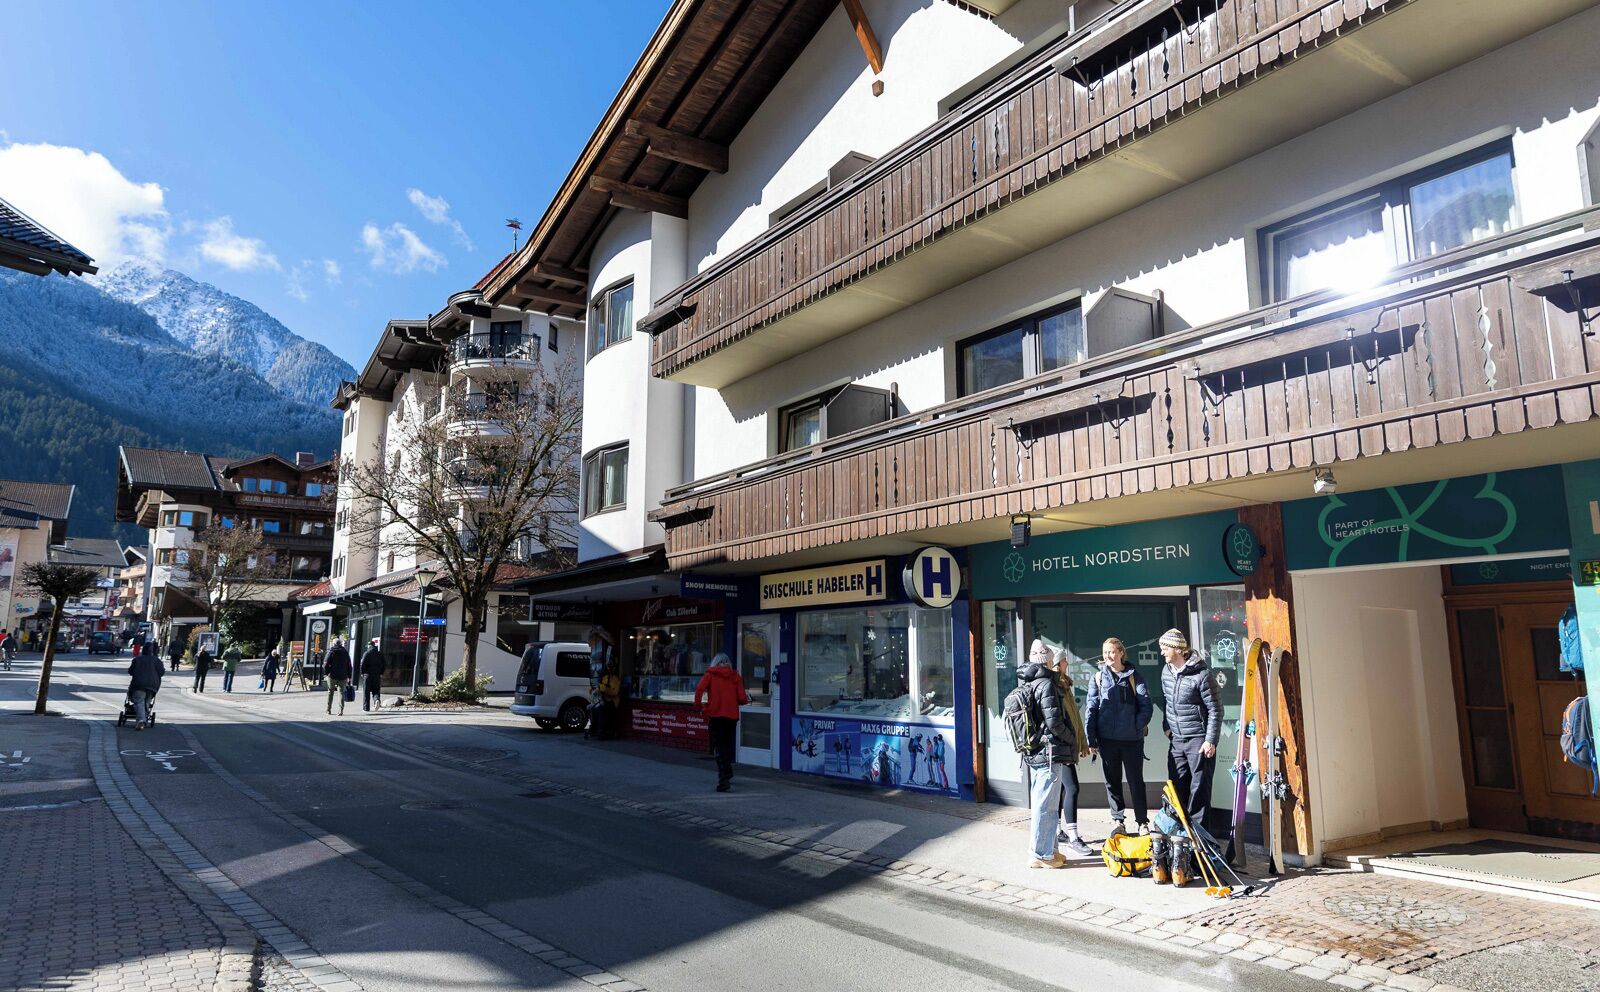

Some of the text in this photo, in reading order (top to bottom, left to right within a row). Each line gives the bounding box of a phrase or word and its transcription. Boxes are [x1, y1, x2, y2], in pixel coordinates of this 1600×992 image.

[1335, 519, 1375, 529] PART OF
[1336, 524, 1409, 538] HEART HOTELS
[1032, 543, 1190, 571] HOTEL NORDSTERN
[763, 564, 882, 600] SKISCHULE HABELER H
[922, 556, 951, 598] H
[705, 583, 738, 591] MEMORIES
[813, 720, 835, 730] PRIVAT
[861, 723, 909, 736] MAX6 GRUPPE
